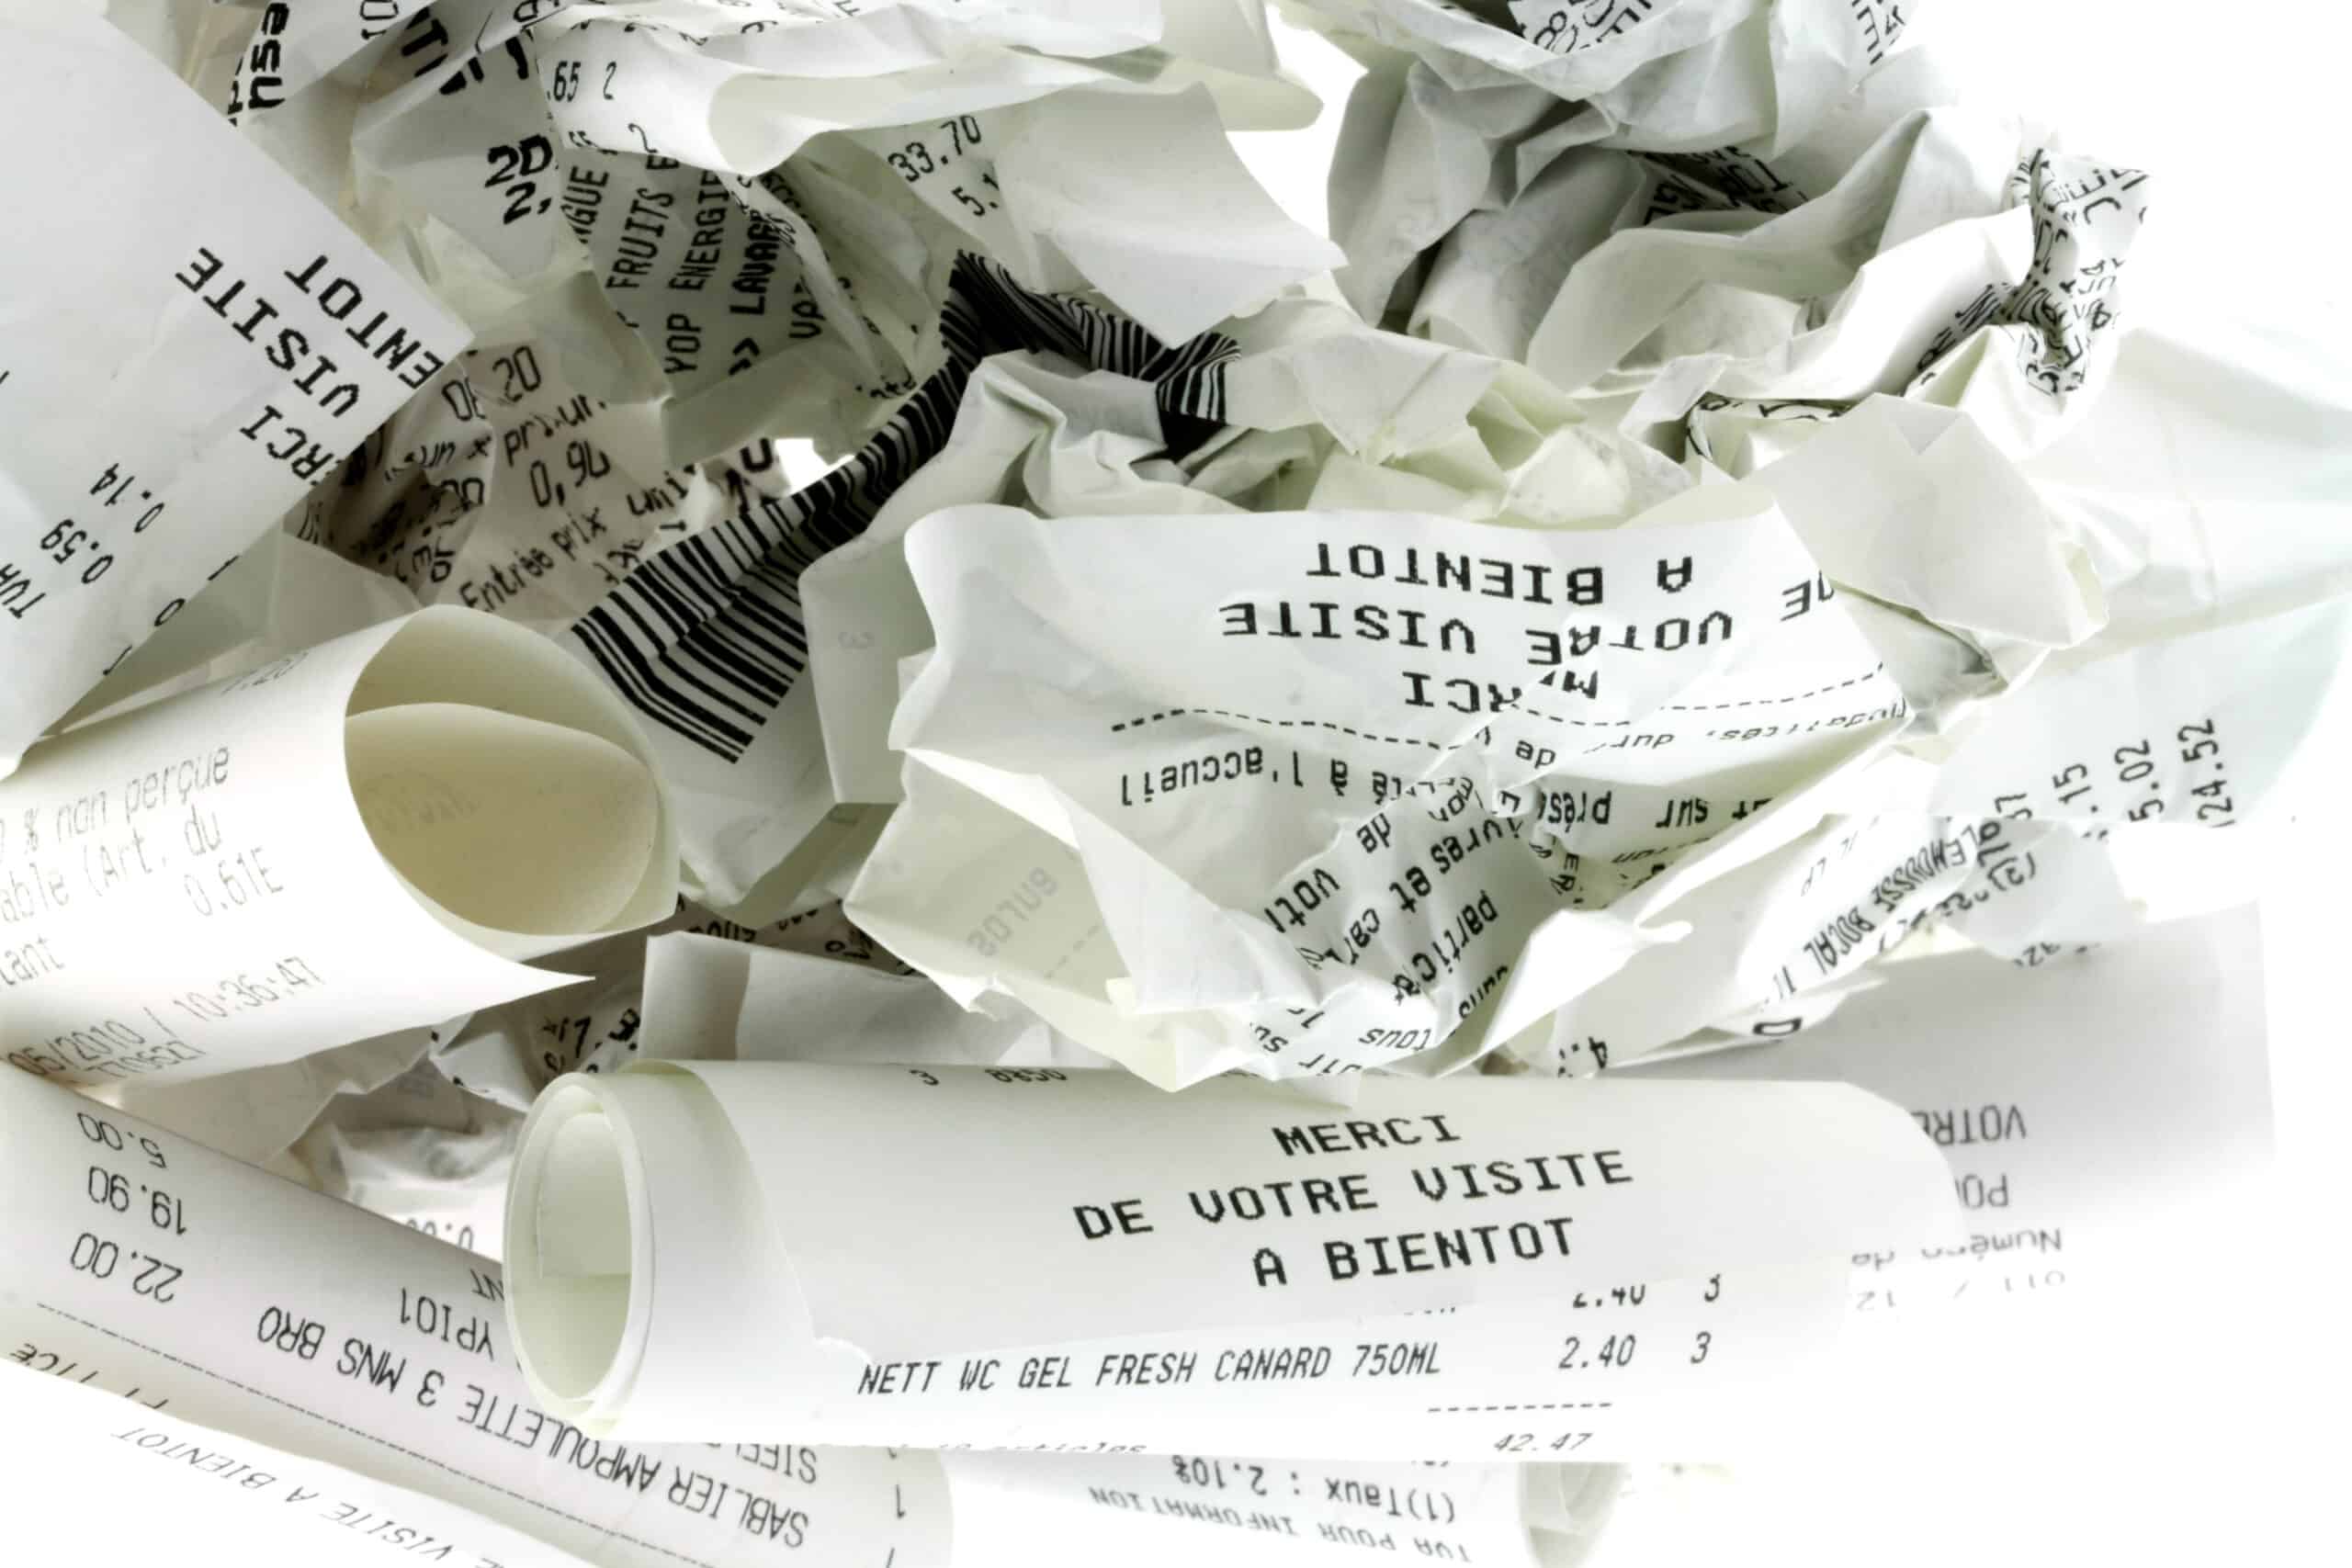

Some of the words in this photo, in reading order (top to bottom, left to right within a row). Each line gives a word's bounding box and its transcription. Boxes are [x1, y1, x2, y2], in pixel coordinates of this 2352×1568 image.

[888, 114, 982, 183] 33.70
[605, 187, 674, 289] FRUITS
[175, 247, 361, 418] VISITE
[663, 312, 703, 374] YOP
[239, 405, 341, 486] RCI
[90, 463, 164, 533] 0.14
[40, 519, 114, 584] 0.59
[1306, 543, 1604, 606] BIENTOT
[1657, 556, 1693, 593] A
[1219, 602, 1476, 655] VISITE
[1120, 745, 1305, 807] l'accueil
[1330, 759, 1350, 796] à
[1516, 739, 1556, 769] de
[2114, 739, 2165, 821] 5.02
[56, 790, 108, 844] non
[125, 745, 231, 823] perçue
[1656, 797, 1709, 829] sur
[184, 805, 222, 860] du
[1356, 813, 1392, 854] de
[183, 847, 285, 919] 0.61E
[1388, 865, 1432, 913] et
[172, 956, 328, 1023] 10:36:47
[76, 1111, 167, 1168] 5.00
[1272, 1114, 1462, 1157] MERCI
[86, 1166, 187, 1236] 19.90
[1073, 1199, 1153, 1240] DE
[1188, 1174, 1378, 1224] VOTRE
[1412, 1149, 1634, 1201] VISITE
[1954, 1173, 2011, 1210] PO
[69, 1232, 184, 1303] 22.00
[1252, 1247, 1288, 1287] A
[1324, 1217, 1574, 1281] BIENTOT
[337, 1337, 407, 1394] MNS
[416, 1369, 446, 1407] 3
[857, 1359, 942, 1394] NETT
[958, 1359, 1001, 1392] WC
[1018, 1356, 1074, 1390] GEL
[1094, 1352, 1197, 1388] FRESH
[1215, 1347, 1331, 1382] CANARD
[1351, 1343, 1442, 1377] 750ML
[1558, 1333, 1637, 1371] 2.40
[1689, 1330, 1713, 1366] 3
[111, 1427, 279, 1492] BIENTOT
[457, 1382, 663, 1491] AMPOULETTE
[1493, 1432, 1594, 1454] 42.47
[285, 1483, 320, 1506] A
[668, 1466, 810, 1550] SABLIER
[1088, 1485, 1300, 1538] INFORMATION
[1326, 1476, 1457, 1524] (1)Taux
[319, 1500, 456, 1562] VISITE
[1317, 1521, 1398, 1552] POUR
